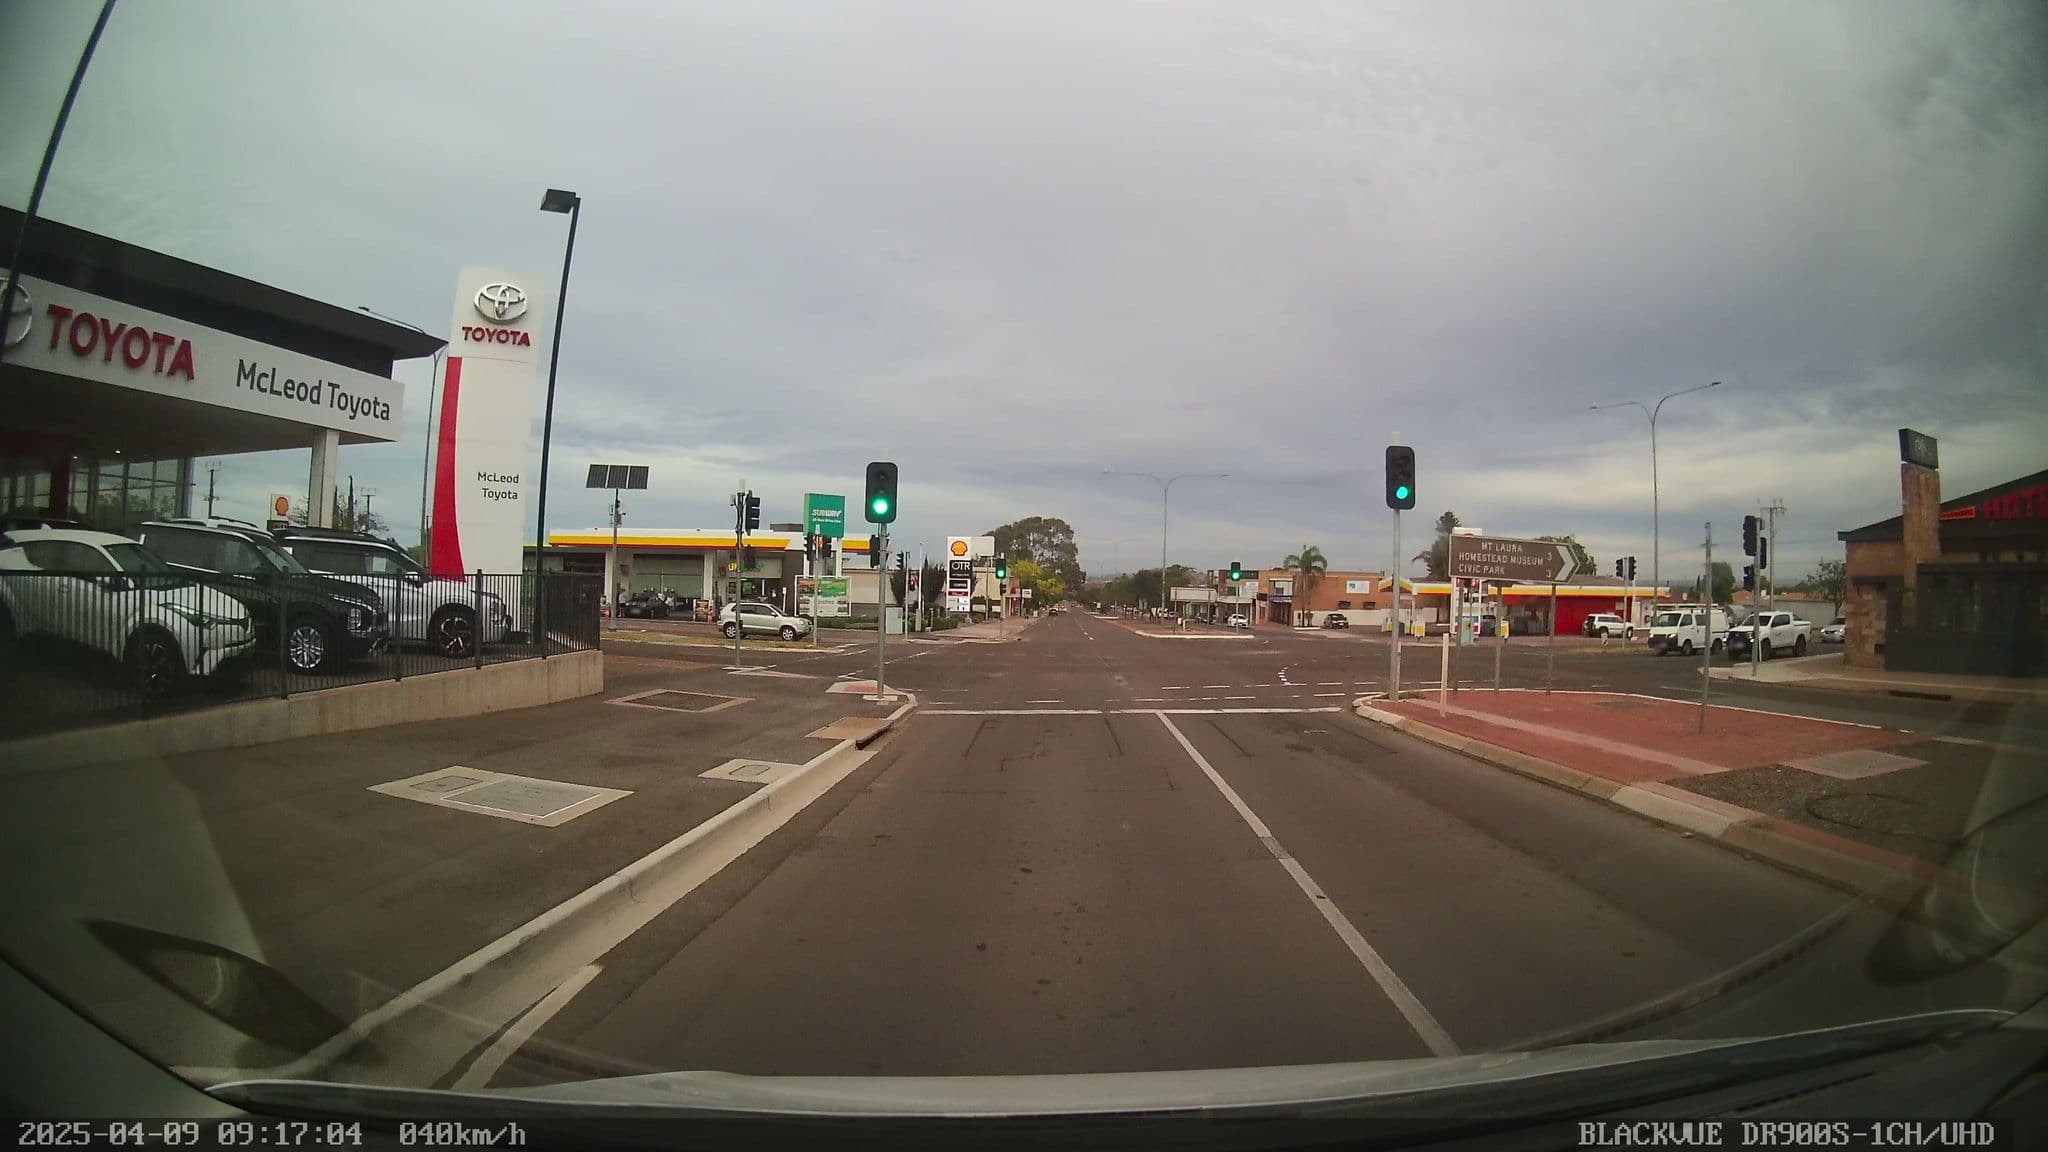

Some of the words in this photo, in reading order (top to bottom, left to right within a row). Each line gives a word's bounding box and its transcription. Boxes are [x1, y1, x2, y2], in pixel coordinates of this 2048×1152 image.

[46, 304, 195, 381] TOYOTA
[462, 326, 531, 346] TOYOTA
[236, 358, 322, 404] McLeod
[327, 382, 391, 421] Toyota
[477, 471, 519, 484] McLeod
[482, 487, 518, 501] Toyota
[1481, 542, 1493, 551] MT
[1495, 543, 1523, 553] LAURA
[1458, 552, 1508, 564] HOMESTEAD
[1510, 556, 1544, 566] MUSEUM
[1547, 552, 1552, 561] 3
[951, 562, 971, 570] OTR
[1458, 564, 1481, 574] CIVIC
[1483, 566, 1505, 575] PARK
